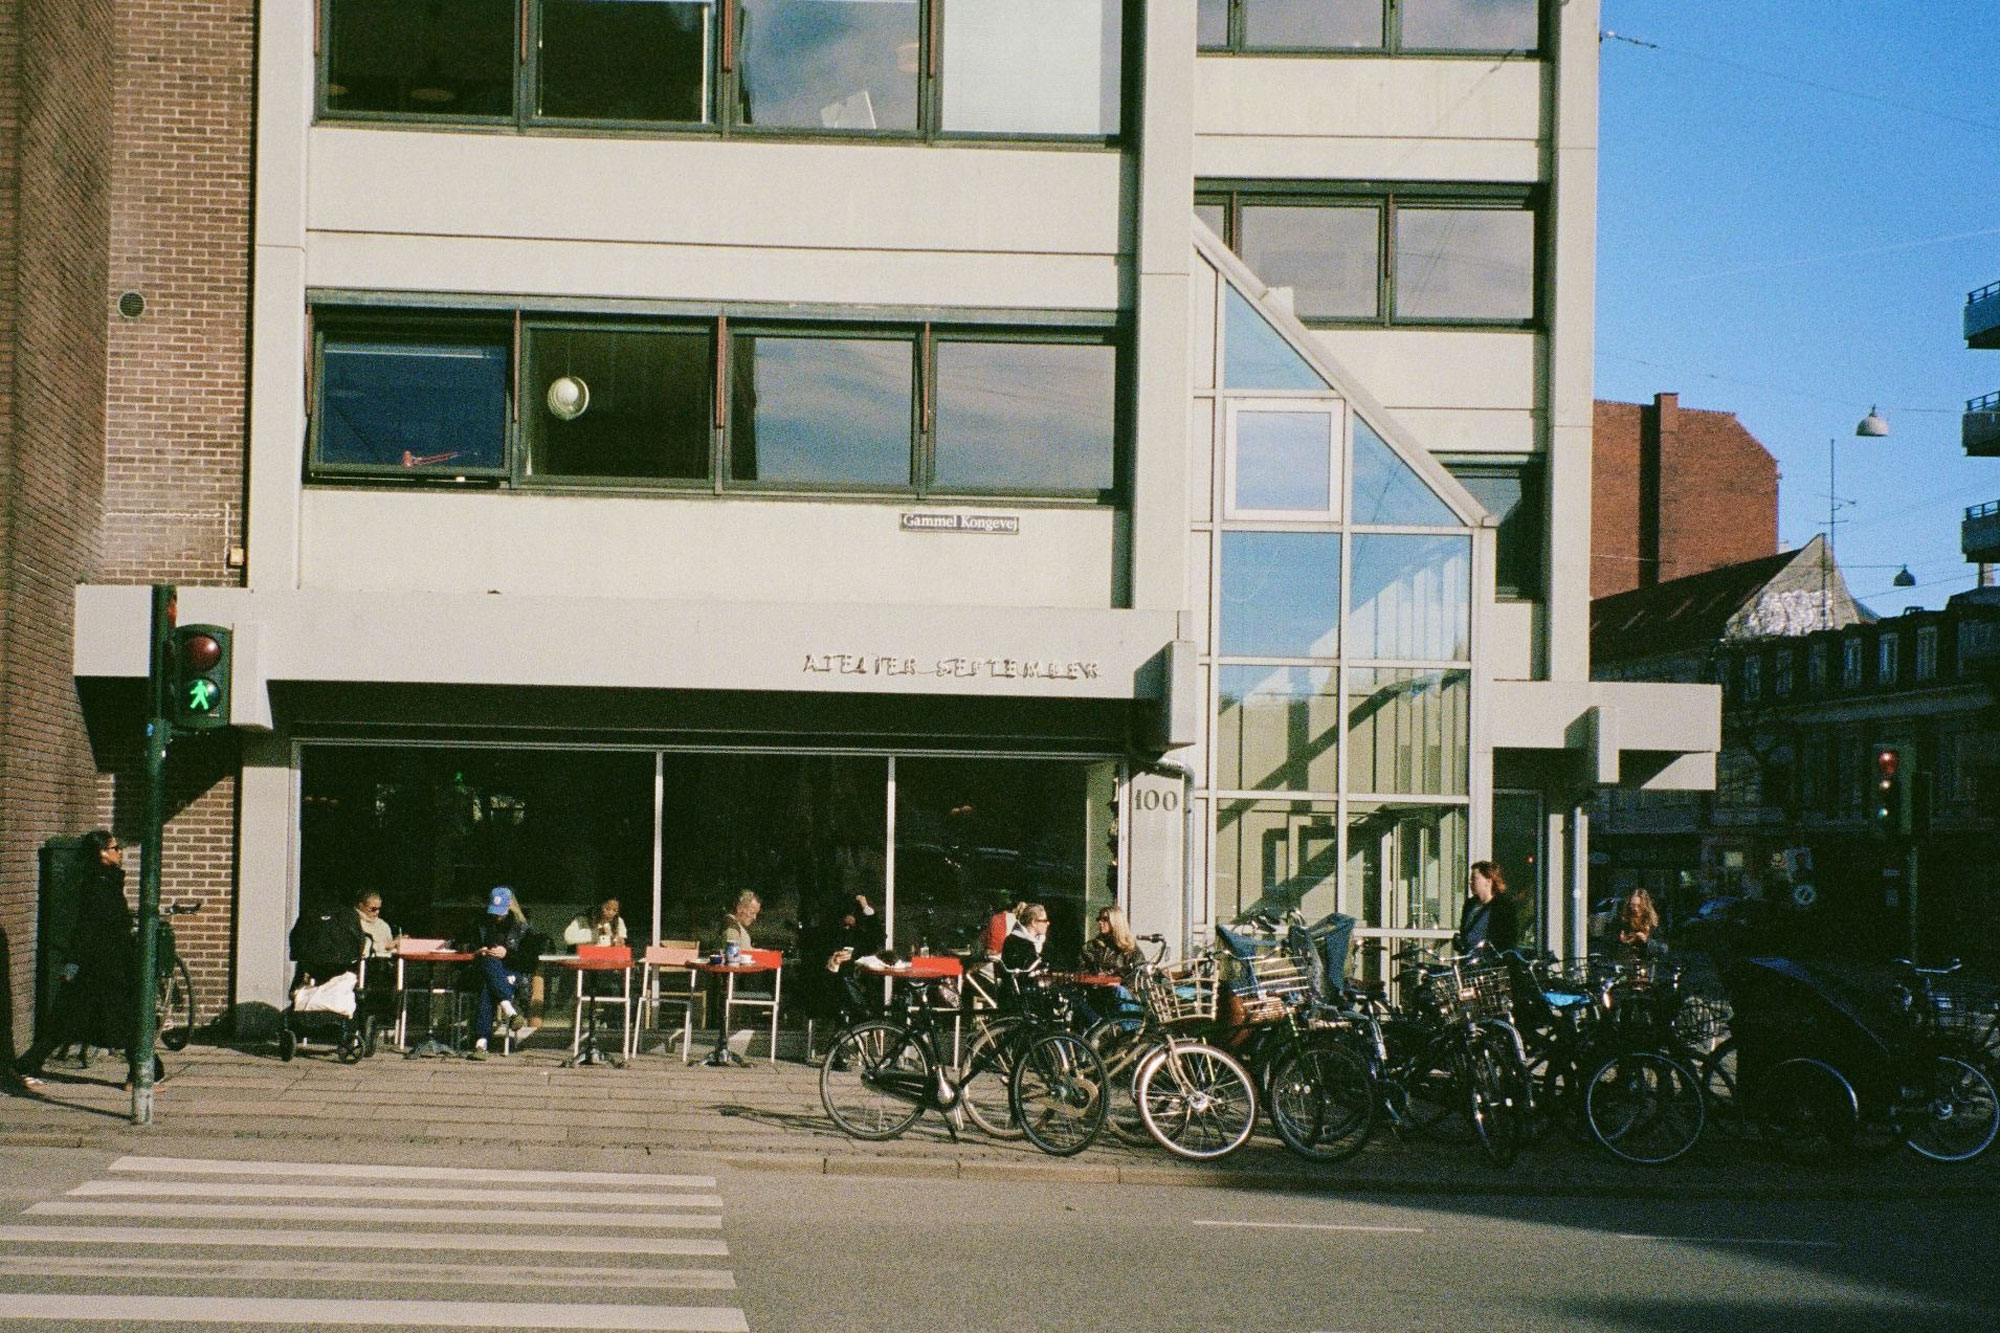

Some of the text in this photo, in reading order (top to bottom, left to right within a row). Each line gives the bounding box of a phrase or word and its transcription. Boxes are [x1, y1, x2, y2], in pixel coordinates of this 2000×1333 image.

[903, 514, 1018, 531] Gammel Kongevej
[1135, 789, 1178, 811] 100
